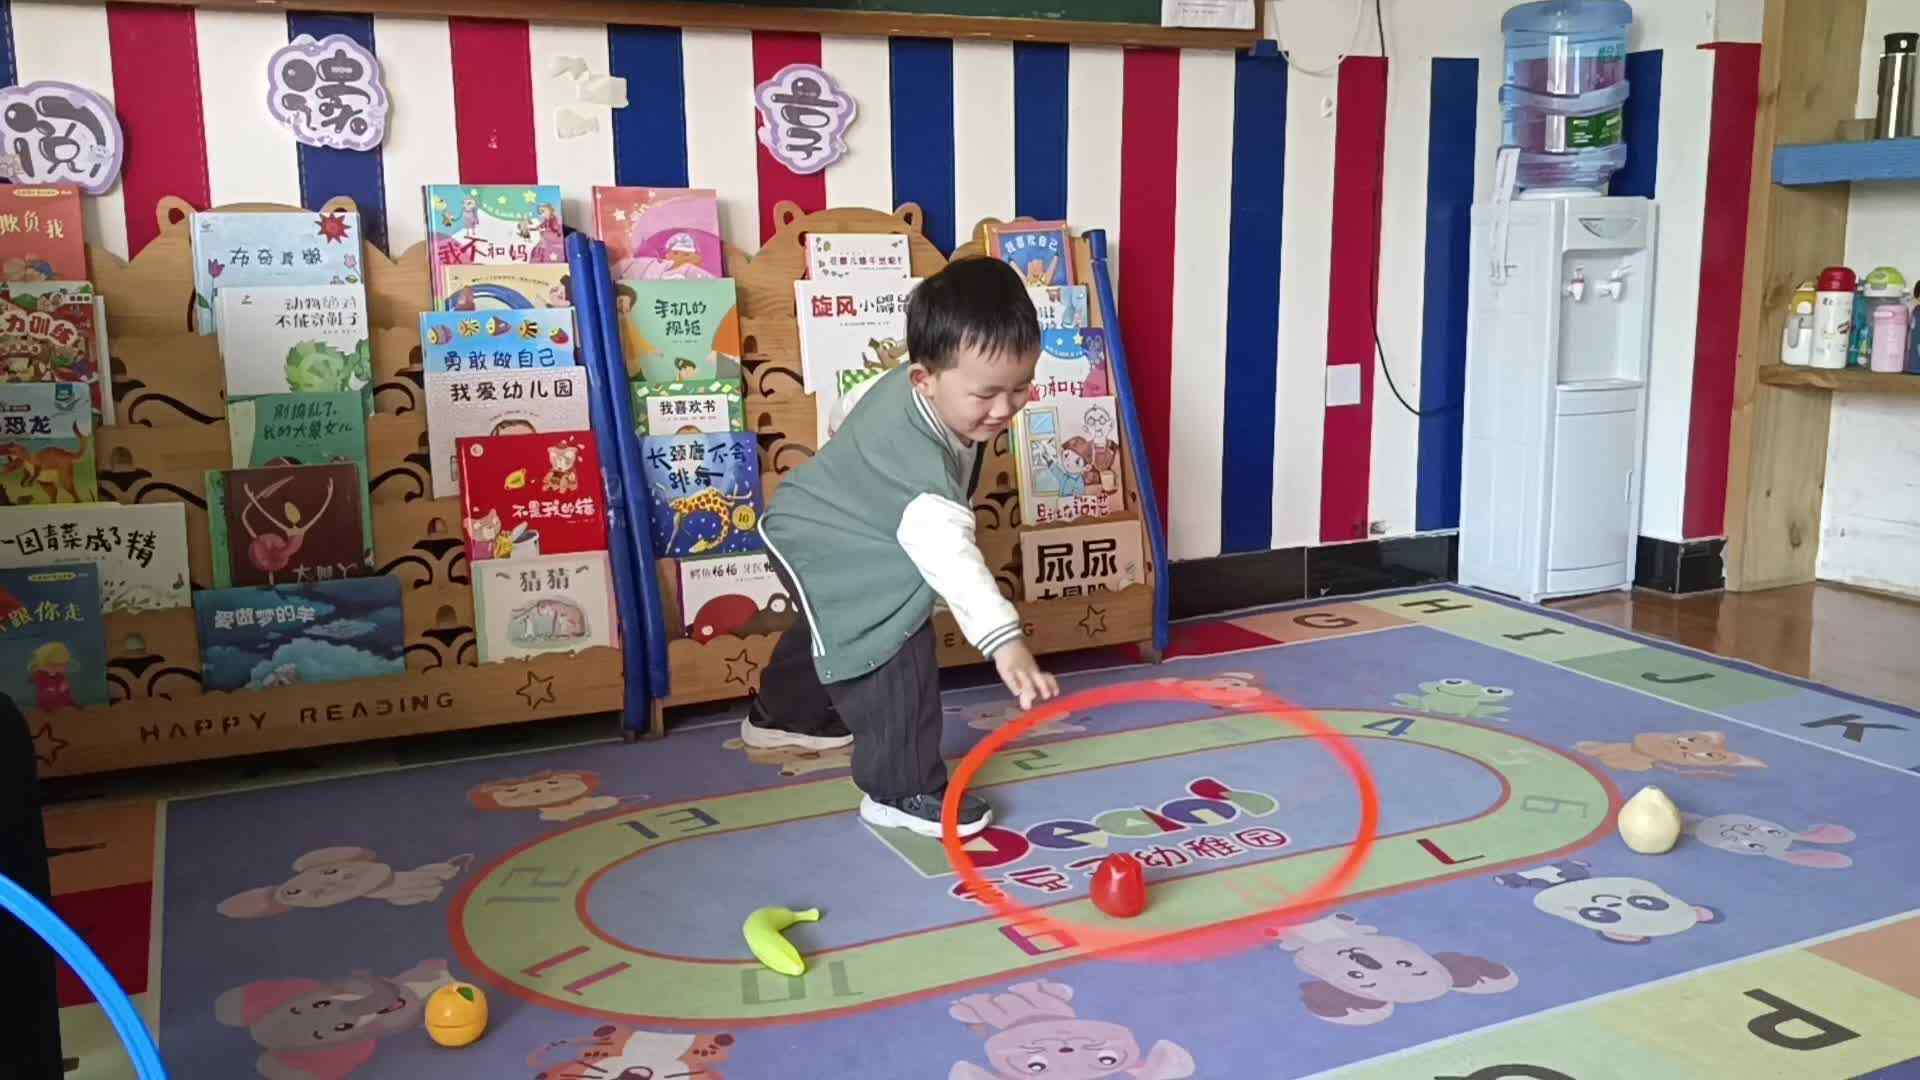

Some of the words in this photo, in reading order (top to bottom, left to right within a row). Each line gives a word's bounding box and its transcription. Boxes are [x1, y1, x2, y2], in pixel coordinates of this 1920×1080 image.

[654, 299, 707, 318] 手机的
[0, 315, 75, 345] 力训练
[444, 348, 556, 372] 勇敢做自己
[450, 378, 574, 402] 我爱幼儿园
[659, 400, 717, 416] 我喜欢书
[0, 416, 52, 435] 恐龙
[647, 441, 747, 471] 长颈鹿不会
[668, 466, 725, 494] 跳舞
[1035, 538, 1119, 584] 尿尿
[520, 567, 570, 592] 猜猜
[1293, 612, 1359, 629] G
[139, 711, 268, 744] HAPPY
[299, 691, 455, 725] READING
[1800, 714, 1910, 743] K
[1743, 987, 1862, 1051] P
